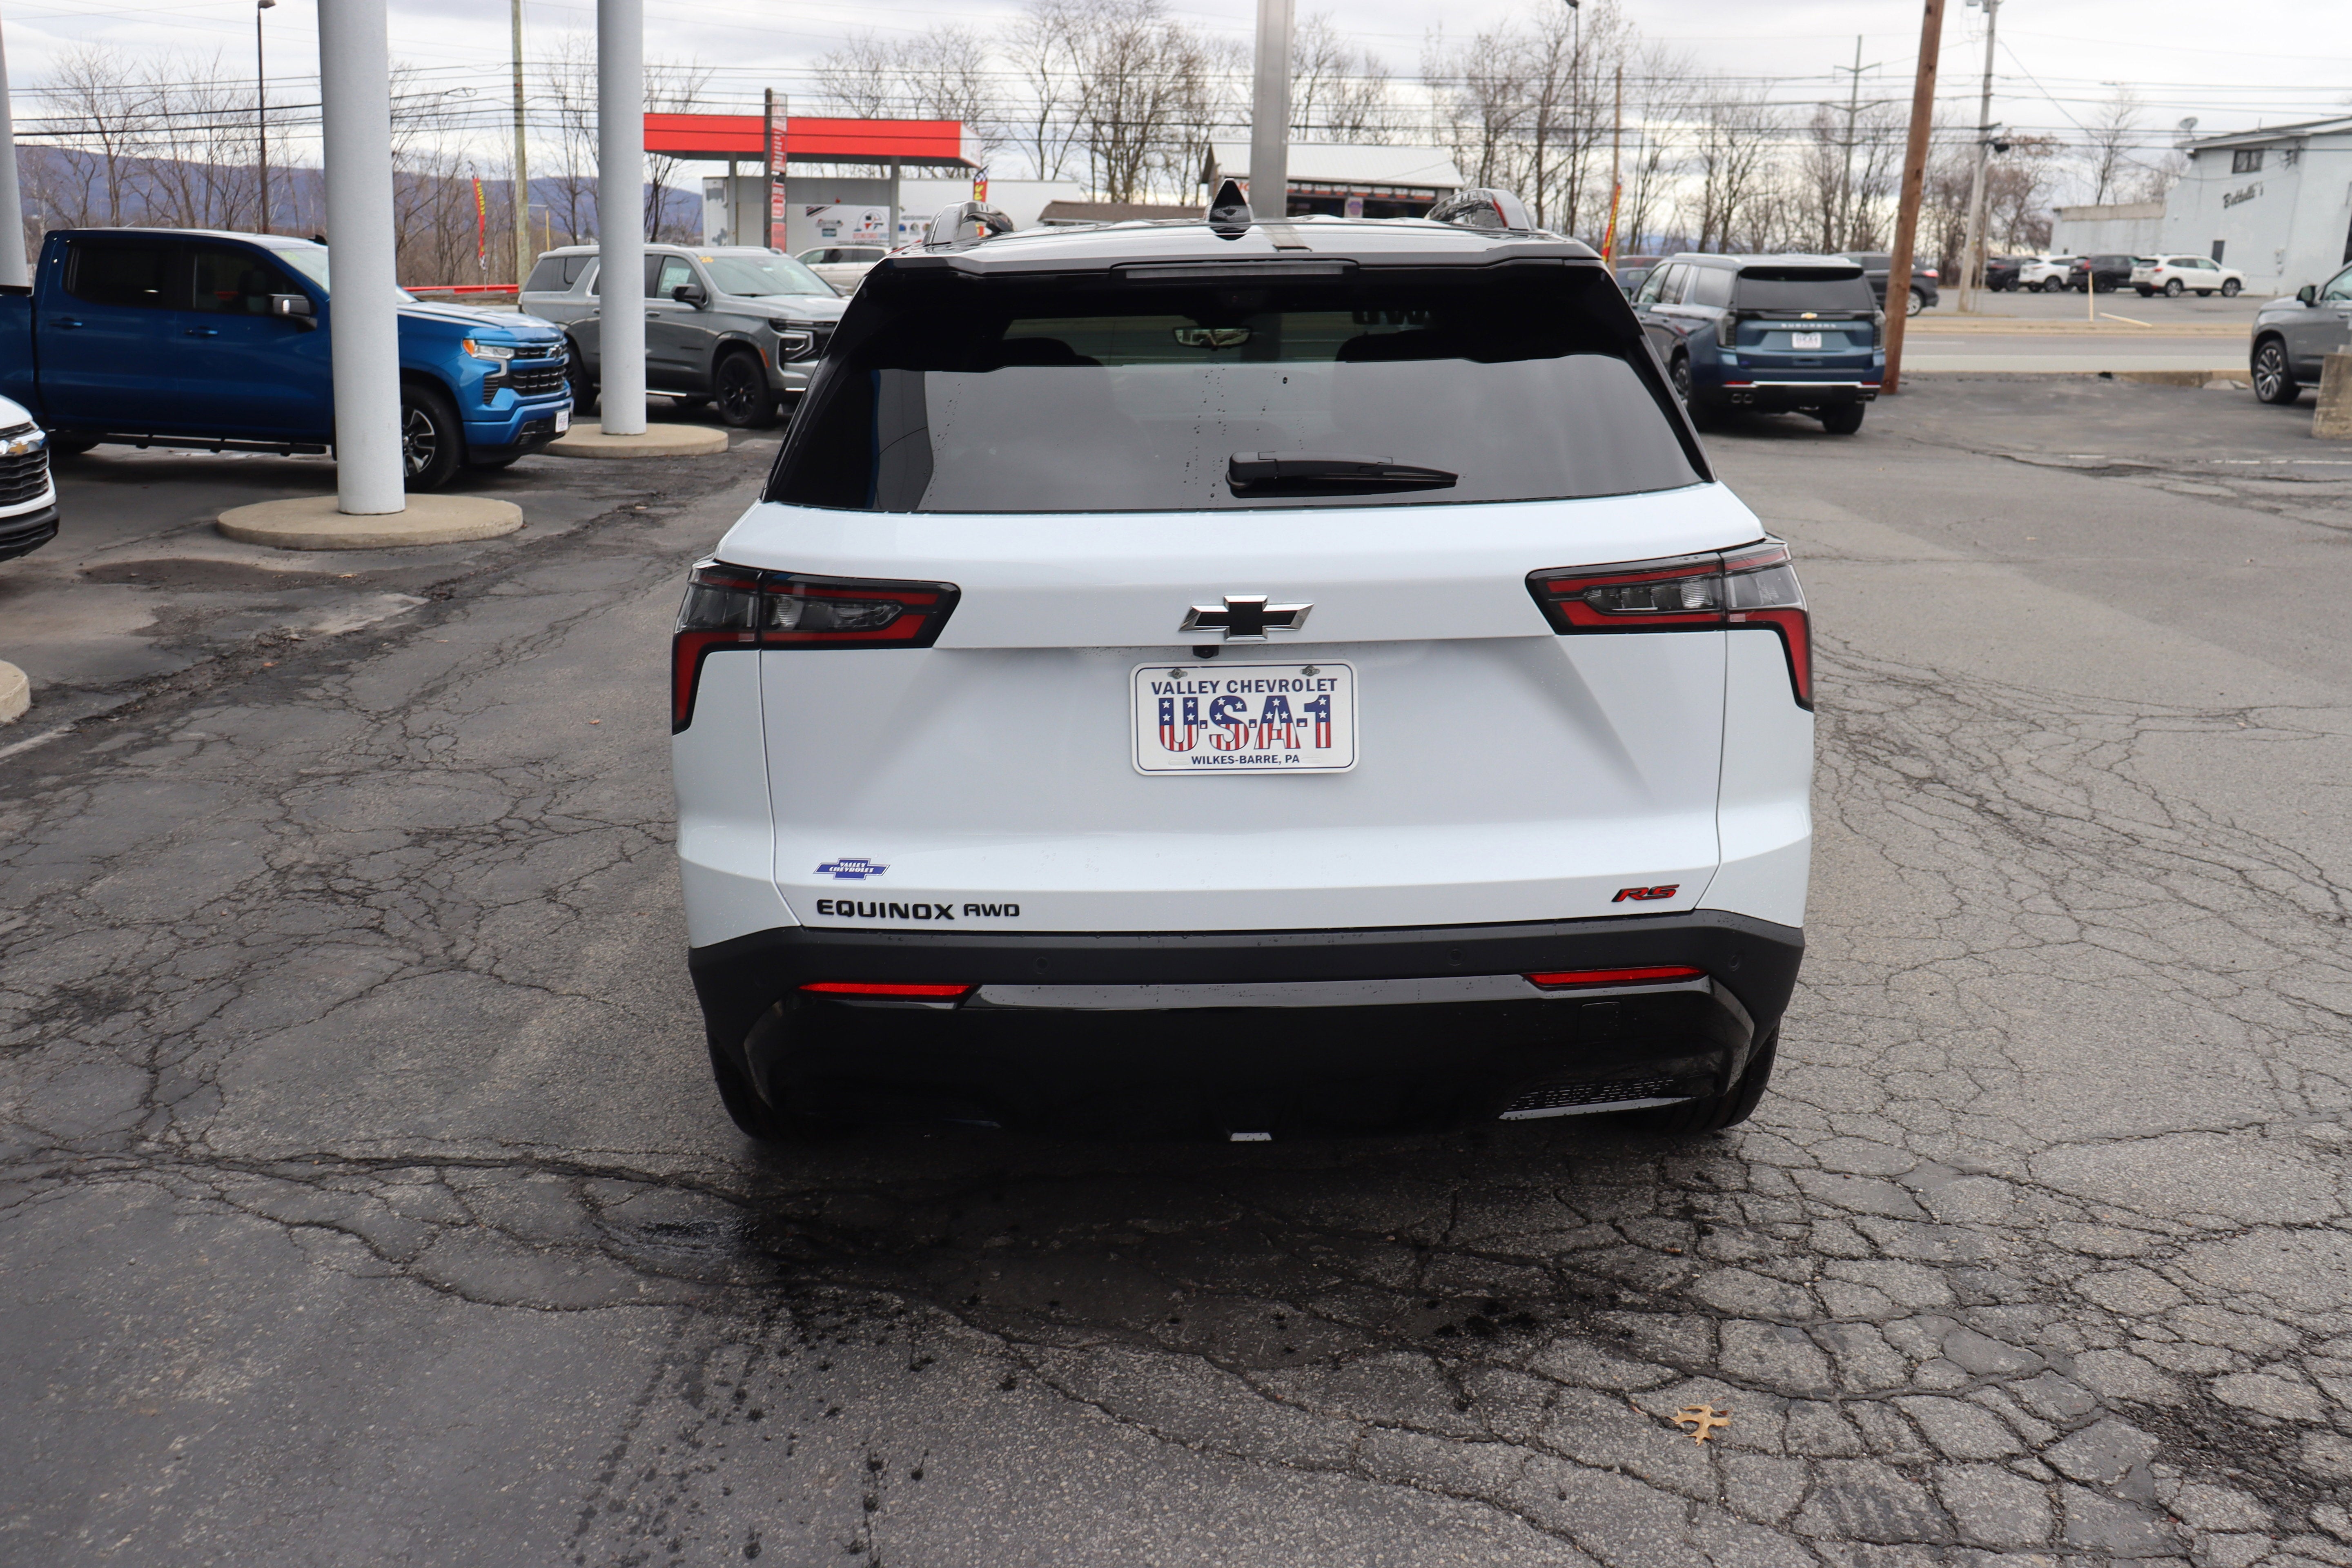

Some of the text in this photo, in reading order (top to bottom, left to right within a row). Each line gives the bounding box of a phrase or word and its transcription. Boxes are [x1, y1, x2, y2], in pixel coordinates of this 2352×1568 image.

[1151, 678, 1337, 695] VALLEY CHEVROLET
[1192, 755, 1300, 765] WILKES-BARRE, PA
[1611, 884, 1680, 902] RS
[816, 899, 1020, 920] EQUINOX AWD
